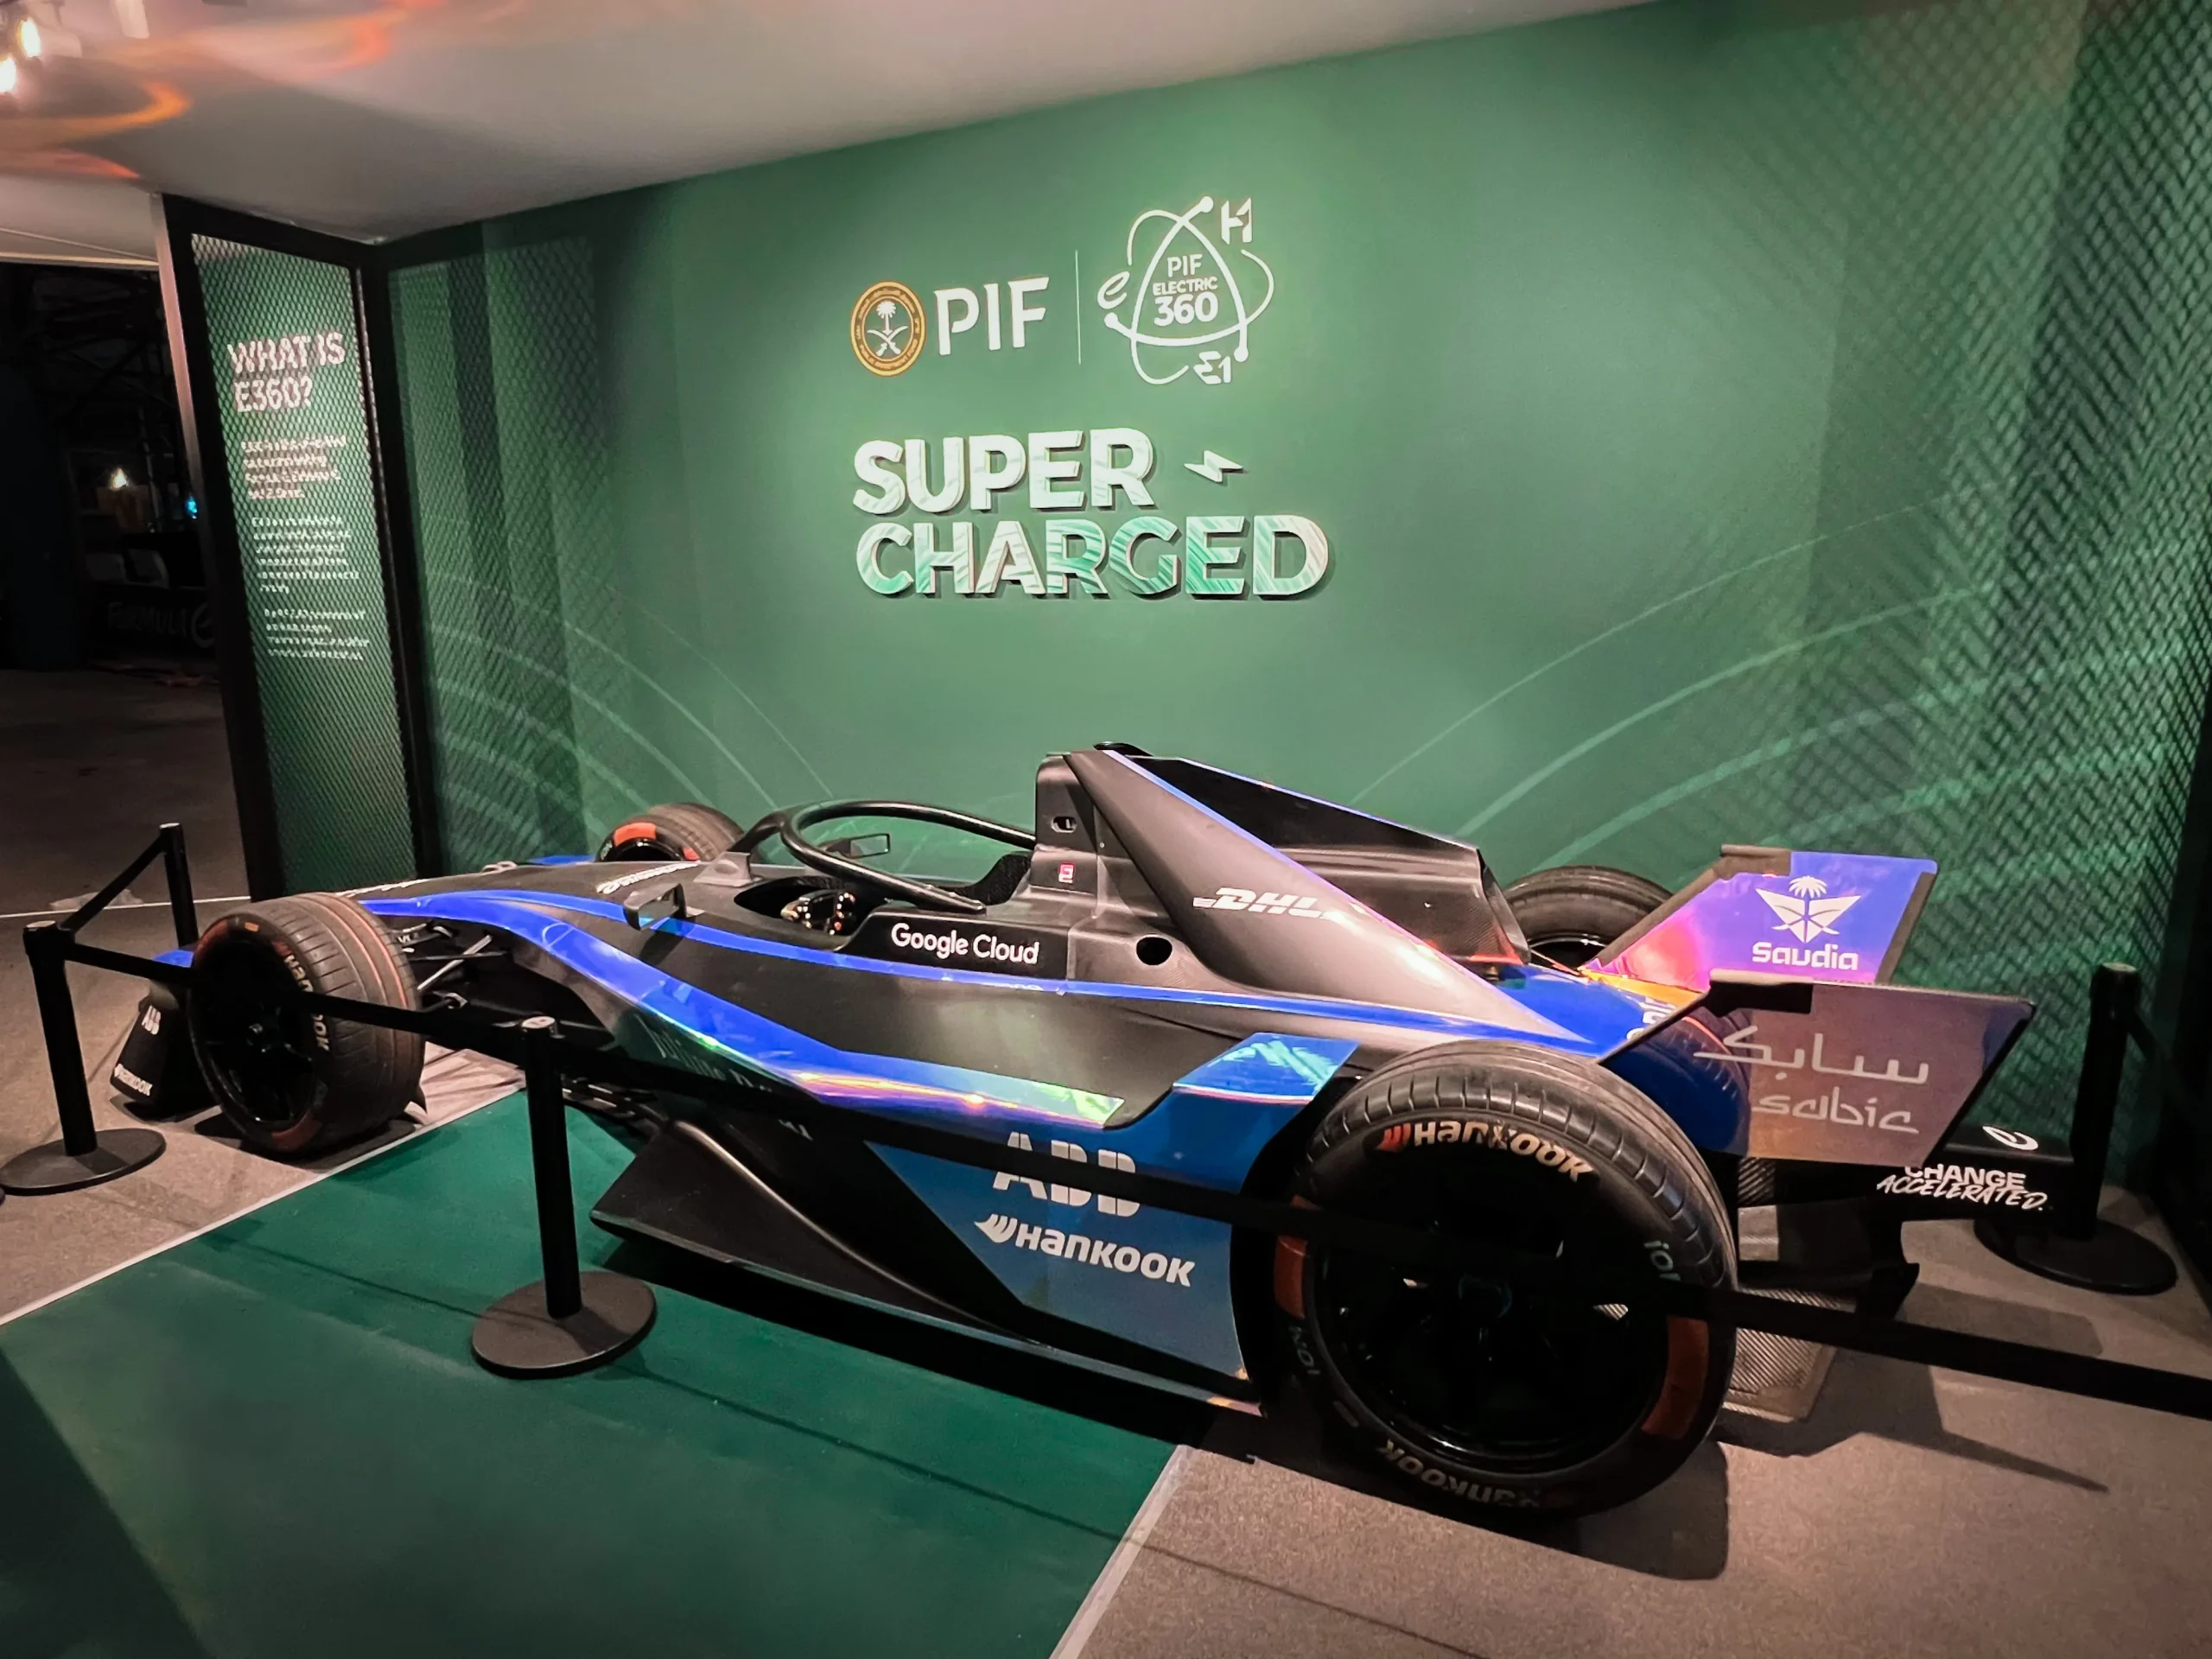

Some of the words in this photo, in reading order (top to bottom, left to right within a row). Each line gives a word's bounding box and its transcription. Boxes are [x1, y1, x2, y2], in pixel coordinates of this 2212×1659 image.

[1166, 254, 1203, 277] PIF
[1153, 276, 1218, 296] ELECTRIC
[934, 276, 1050, 356] PIF
[1154, 292, 1218, 327] 360
[227, 335, 312, 374] WHAT
[317, 332, 345, 365] IS
[234, 375, 313, 412] E360?
[853, 427, 1155, 515] SUPER
[856, 515, 1330, 596] CHARGED
[1211, 887, 1323, 918] DHL
[891, 923, 969, 959] Google
[973, 934, 1040, 964] Cloud
[1753, 942, 1859, 970] Saudia
[1693, 1025, 1929, 1085] سابك
[1751, 1087, 1920, 1135] sabic
[1904, 1164, 2027, 1191] CHANGE
